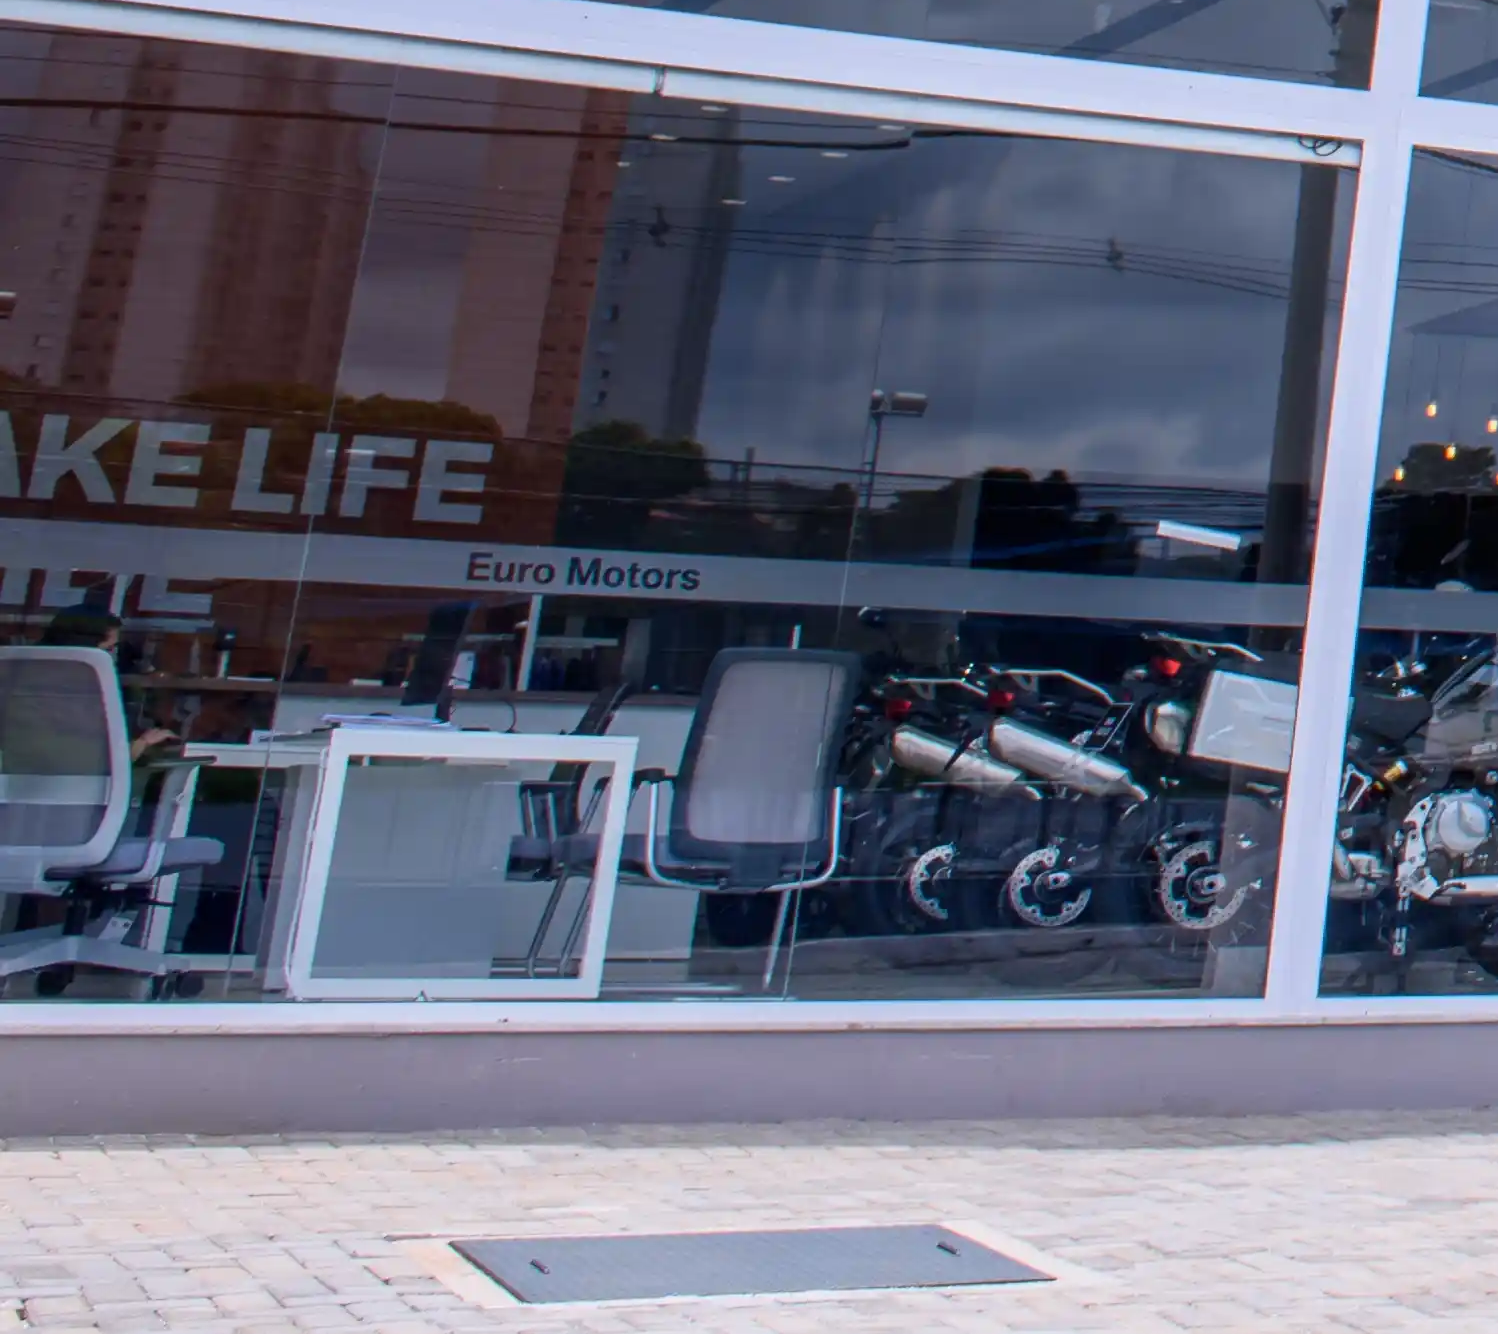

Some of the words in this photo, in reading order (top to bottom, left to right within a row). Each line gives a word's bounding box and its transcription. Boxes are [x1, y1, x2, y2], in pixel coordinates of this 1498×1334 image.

[0, 410, 213, 508] KE
[231, 428, 494, 525] LIFE
[466, 550, 555, 585] Euro
[567, 555, 702, 591] Motors
